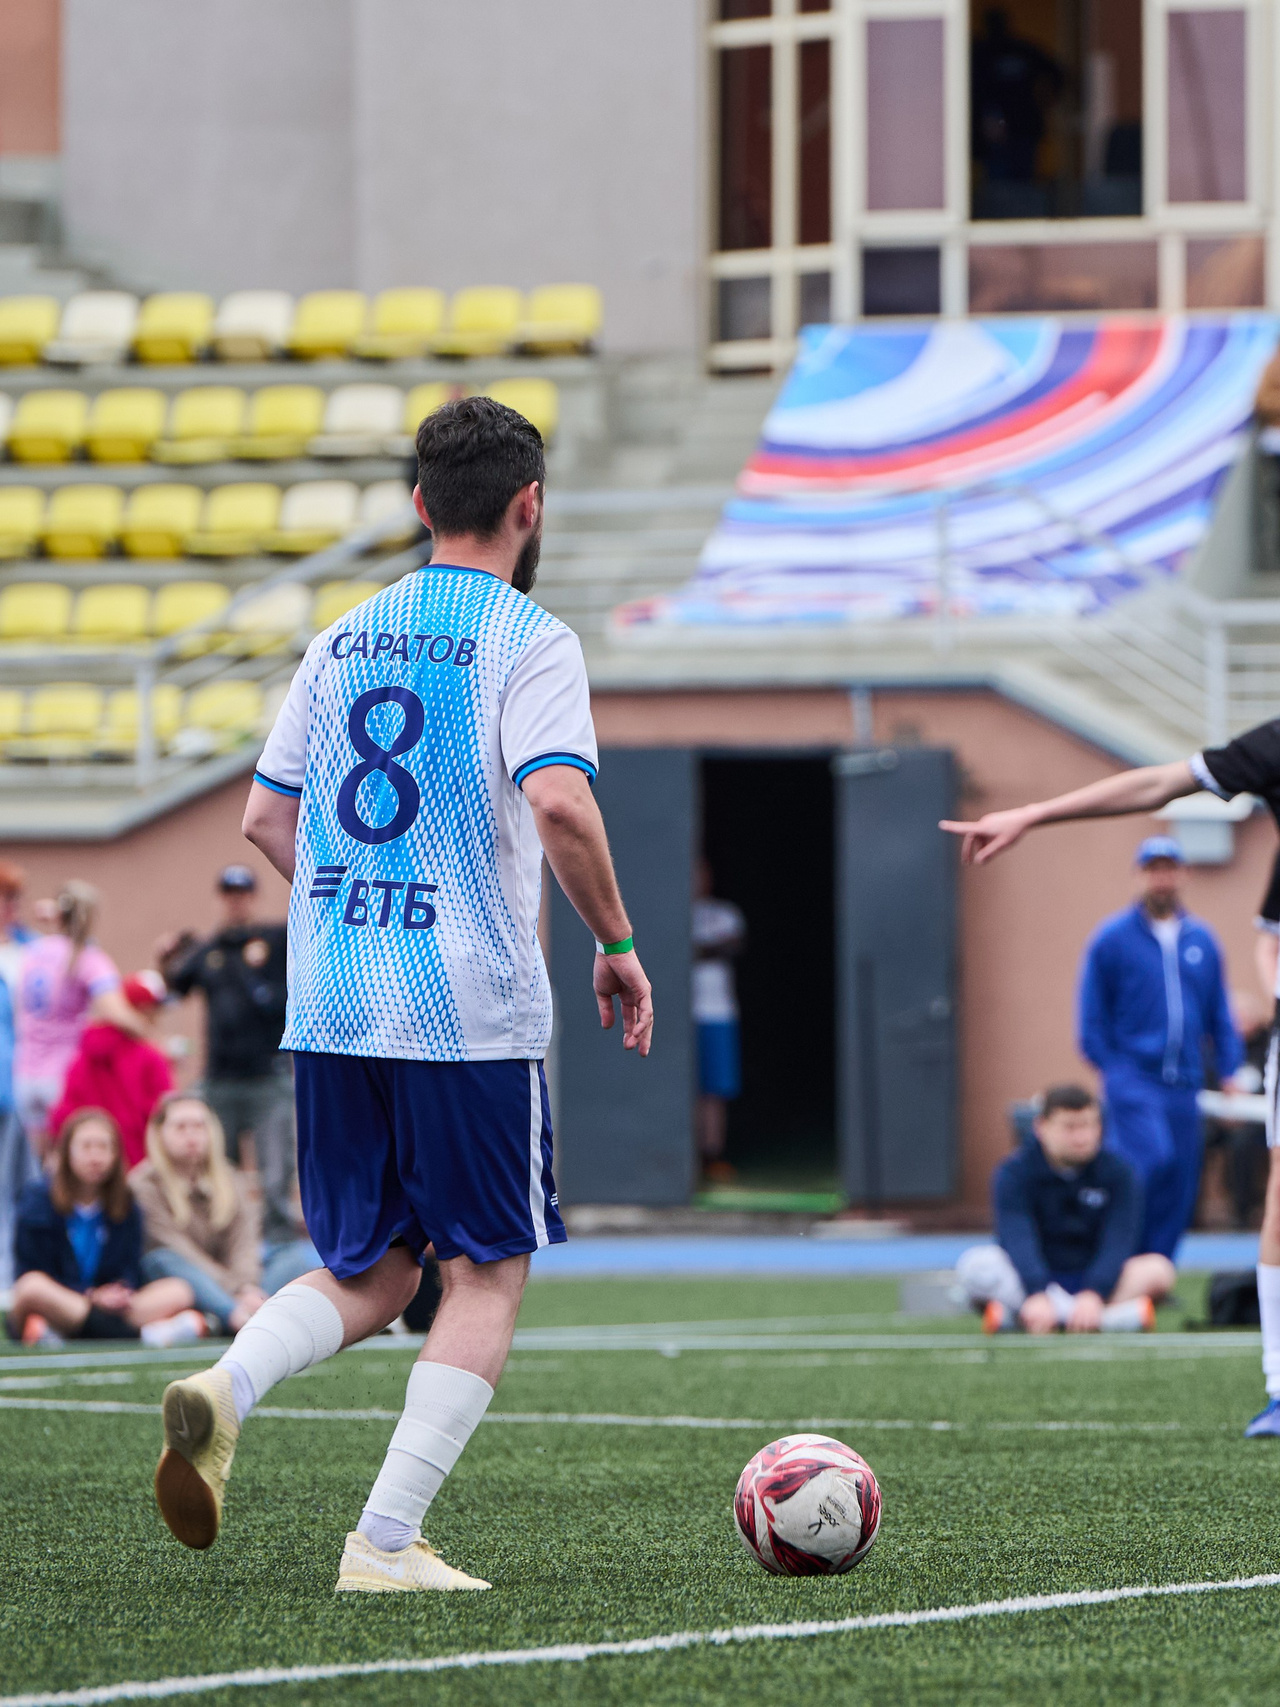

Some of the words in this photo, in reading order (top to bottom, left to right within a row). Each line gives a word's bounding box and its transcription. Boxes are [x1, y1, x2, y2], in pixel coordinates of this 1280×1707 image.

[331, 631, 477, 666] САРАТОВ
[336, 685, 425, 846] 8
[342, 879, 439, 930] ВТБ
